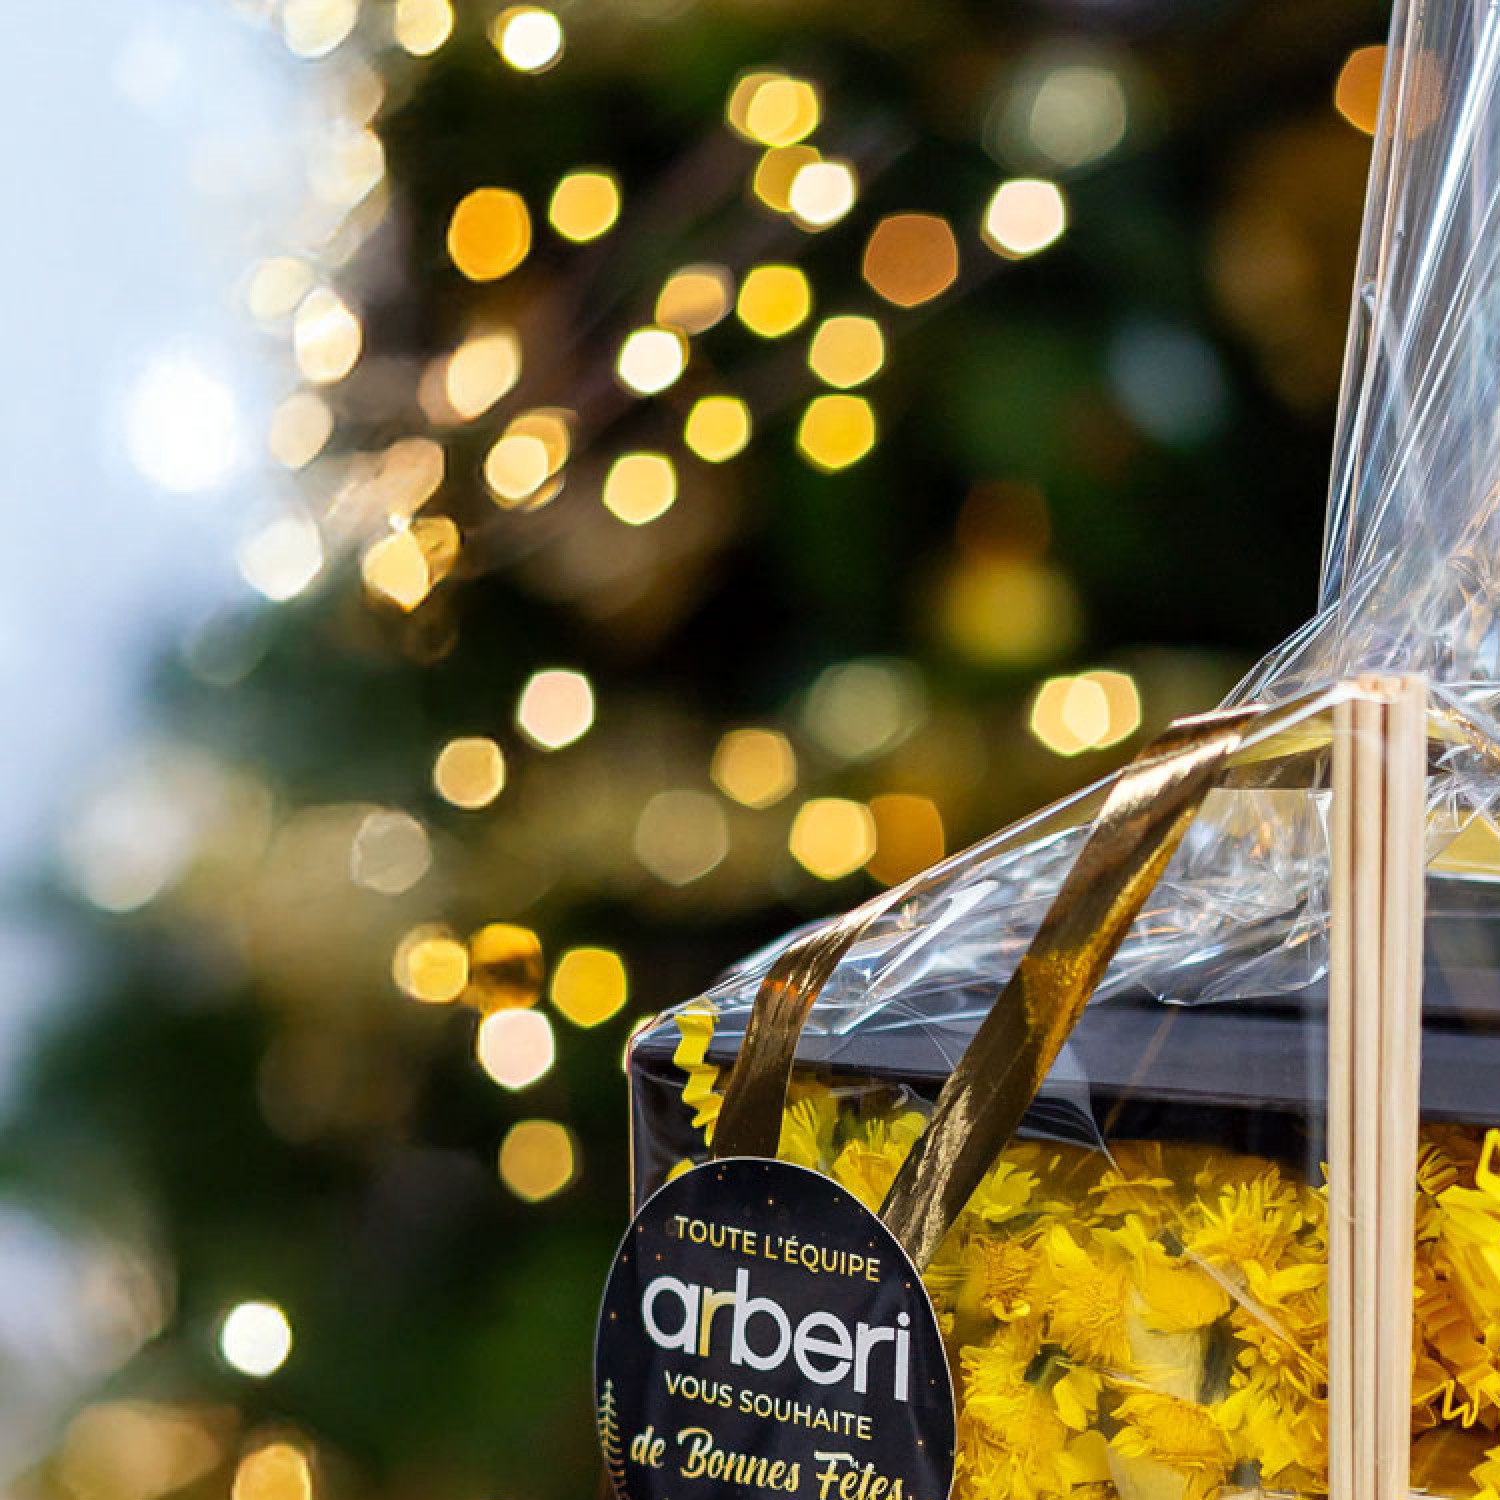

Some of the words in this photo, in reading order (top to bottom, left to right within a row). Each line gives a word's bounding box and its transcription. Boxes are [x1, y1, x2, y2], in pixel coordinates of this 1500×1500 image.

[674, 1215, 757, 1256] TOUTE
[763, 1236, 881, 1283] L'ÉQUIPE
[641, 1267, 911, 1401] arberi
[664, 1370, 733, 1409] VOUS
[739, 1389, 873, 1441] SOUHAITE
[630, 1425, 667, 1469] de
[677, 1427, 801, 1493] Bonnes
